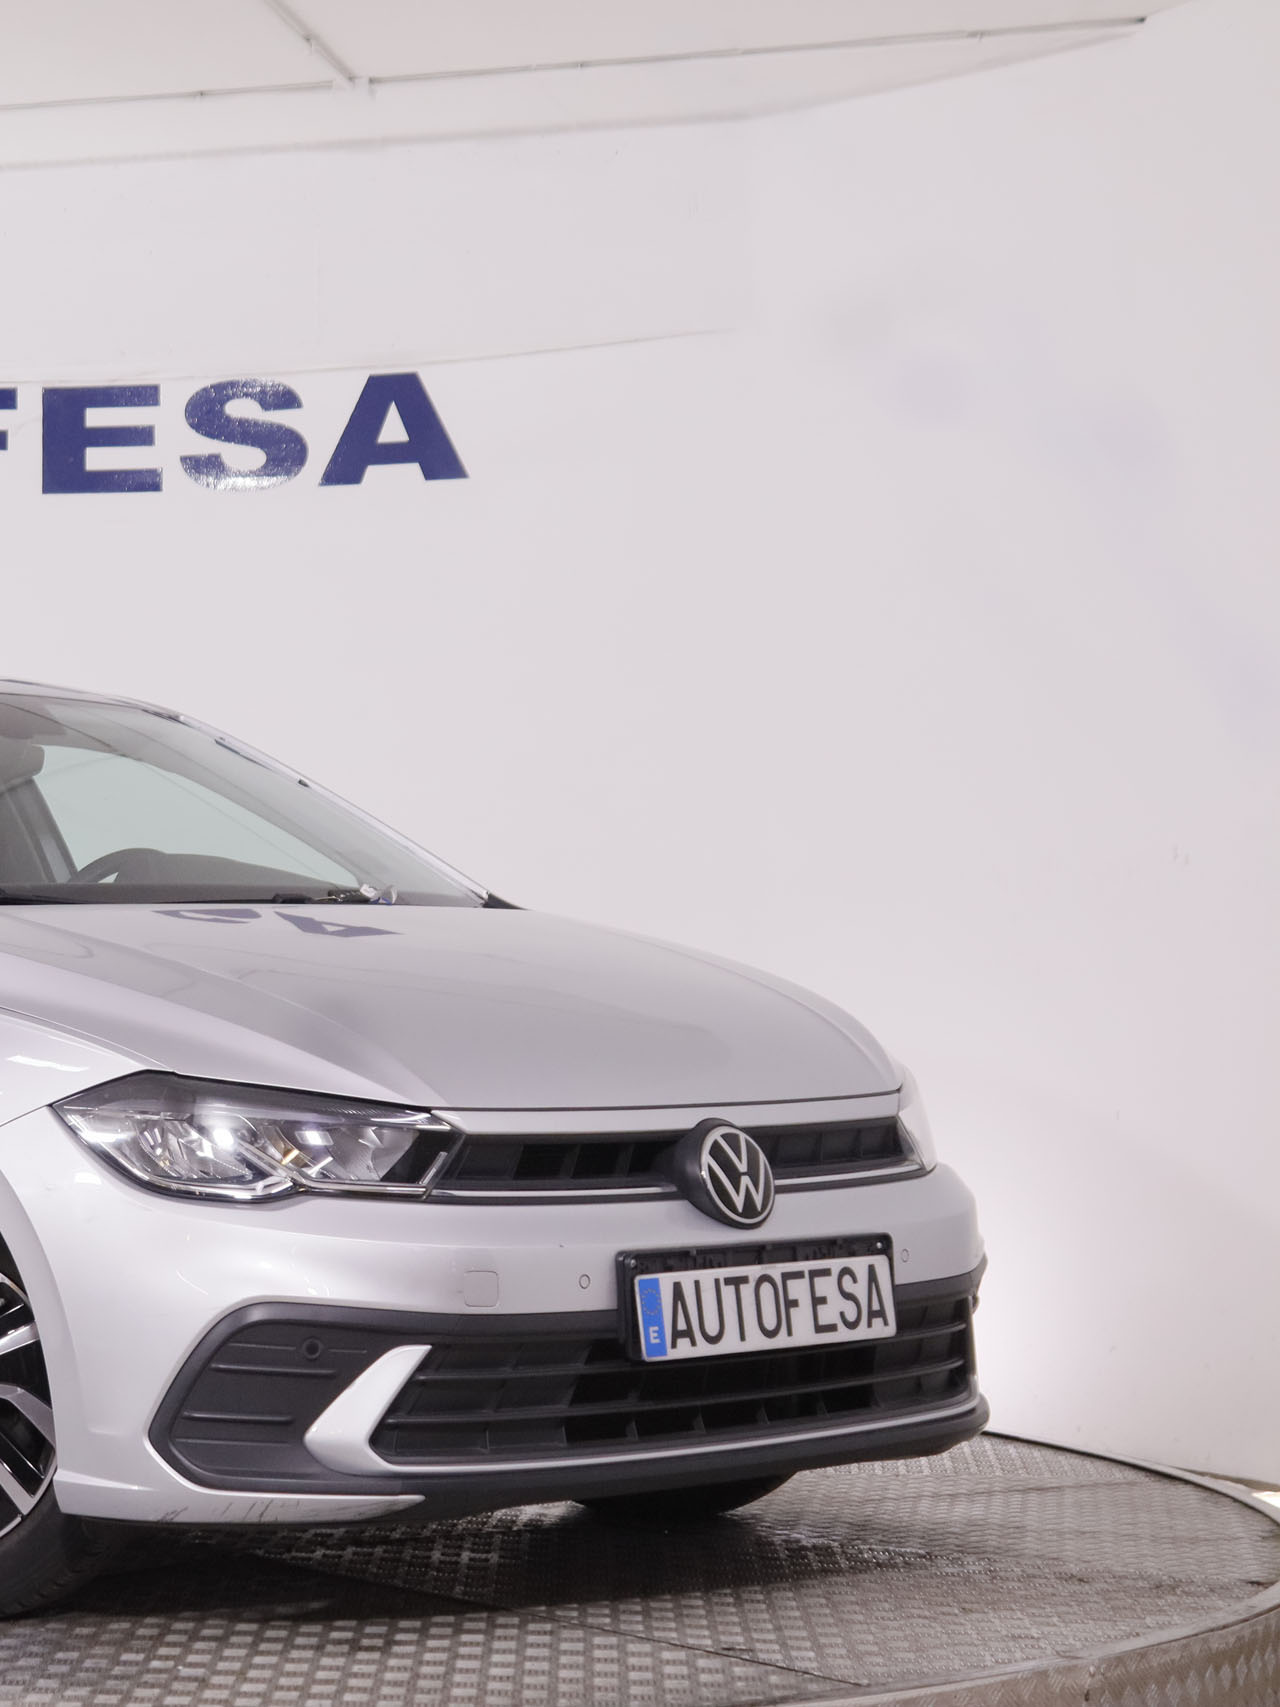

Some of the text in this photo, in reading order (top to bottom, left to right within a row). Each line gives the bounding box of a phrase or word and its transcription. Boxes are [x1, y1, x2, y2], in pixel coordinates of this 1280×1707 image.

[701, 1126, 774, 1223] VW
[650, 1263, 890, 1349] E AUTOFESA
